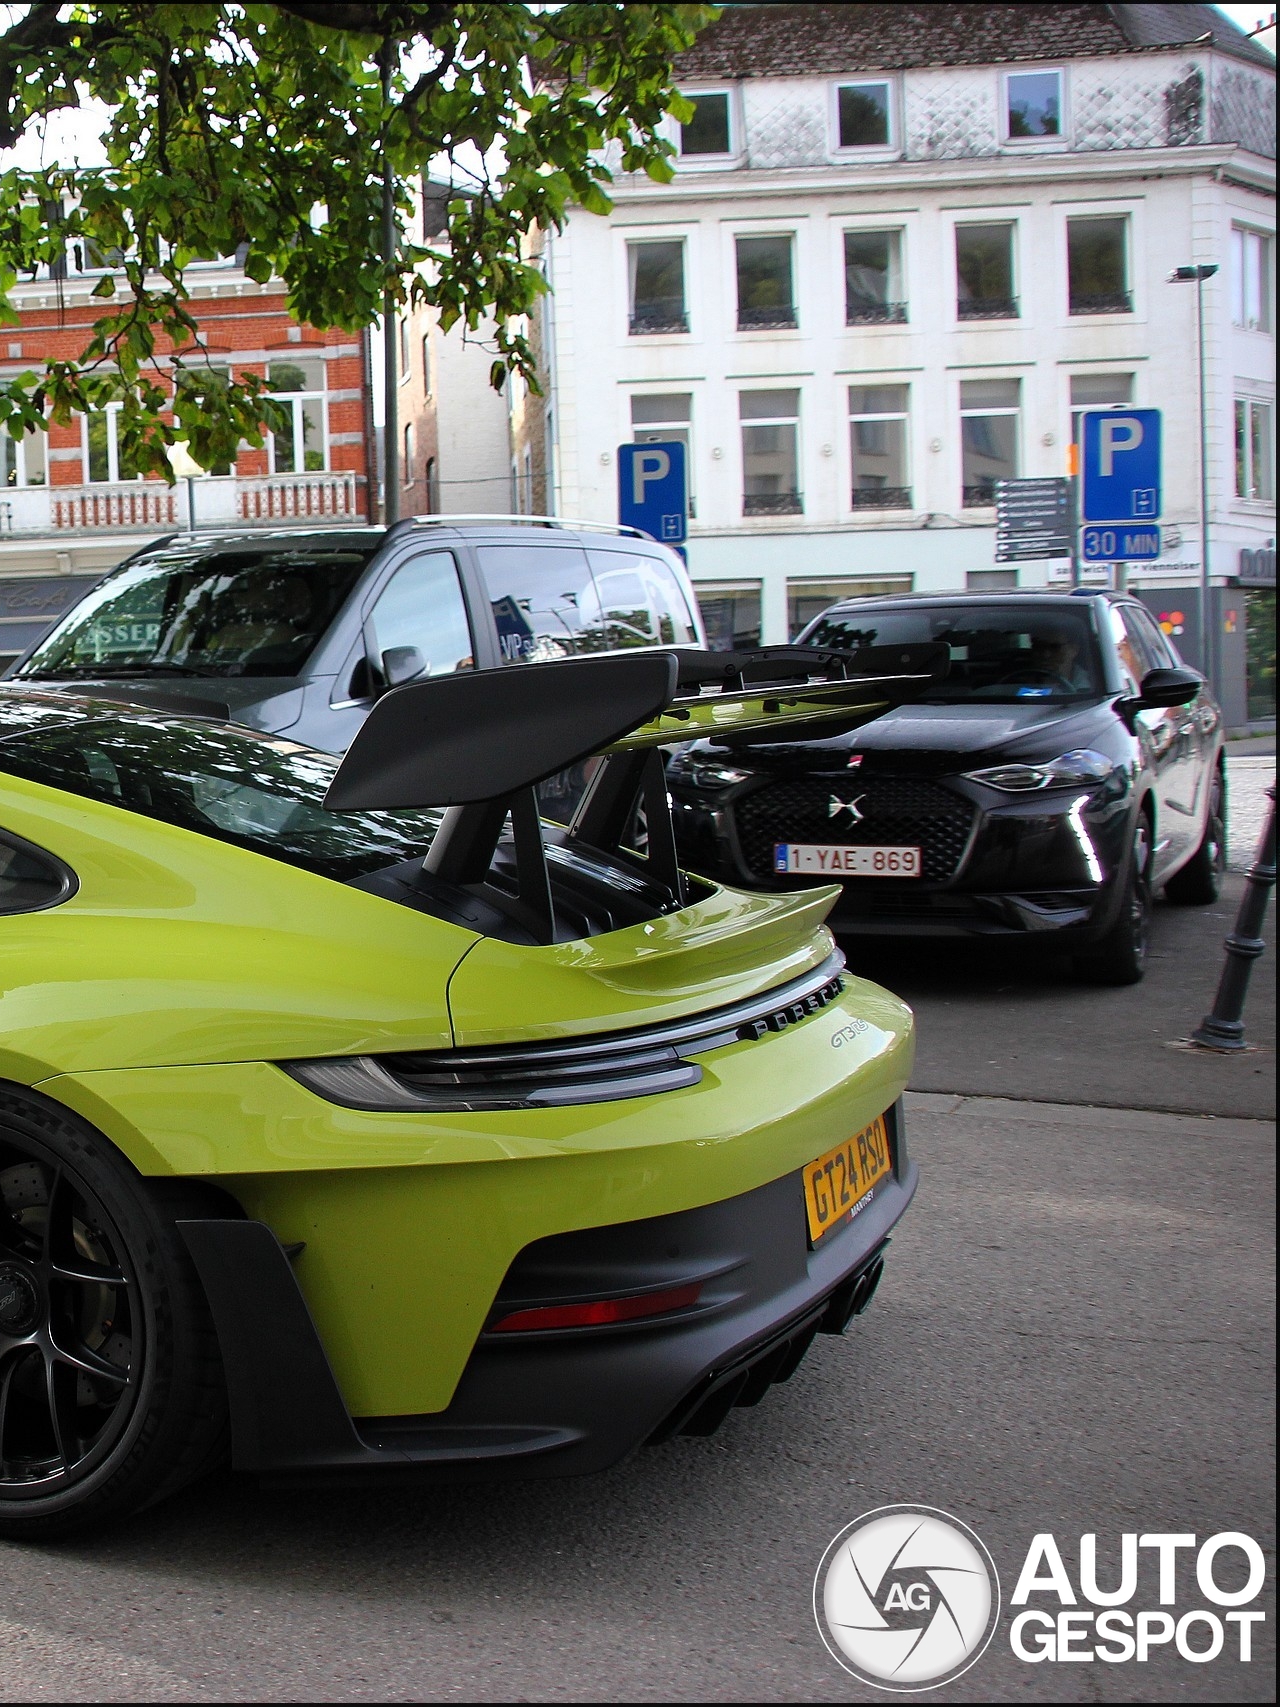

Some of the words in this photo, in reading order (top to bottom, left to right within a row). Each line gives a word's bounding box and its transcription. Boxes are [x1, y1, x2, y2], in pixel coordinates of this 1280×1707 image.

[1099, 417, 1144, 477] P
[632, 449, 671, 505] P
[1085, 531, 1116, 556] 30
[1125, 533, 1159, 555] MIN
[500, 633, 522, 660] VIP
[812, 1144, 858, 1224] GT24
